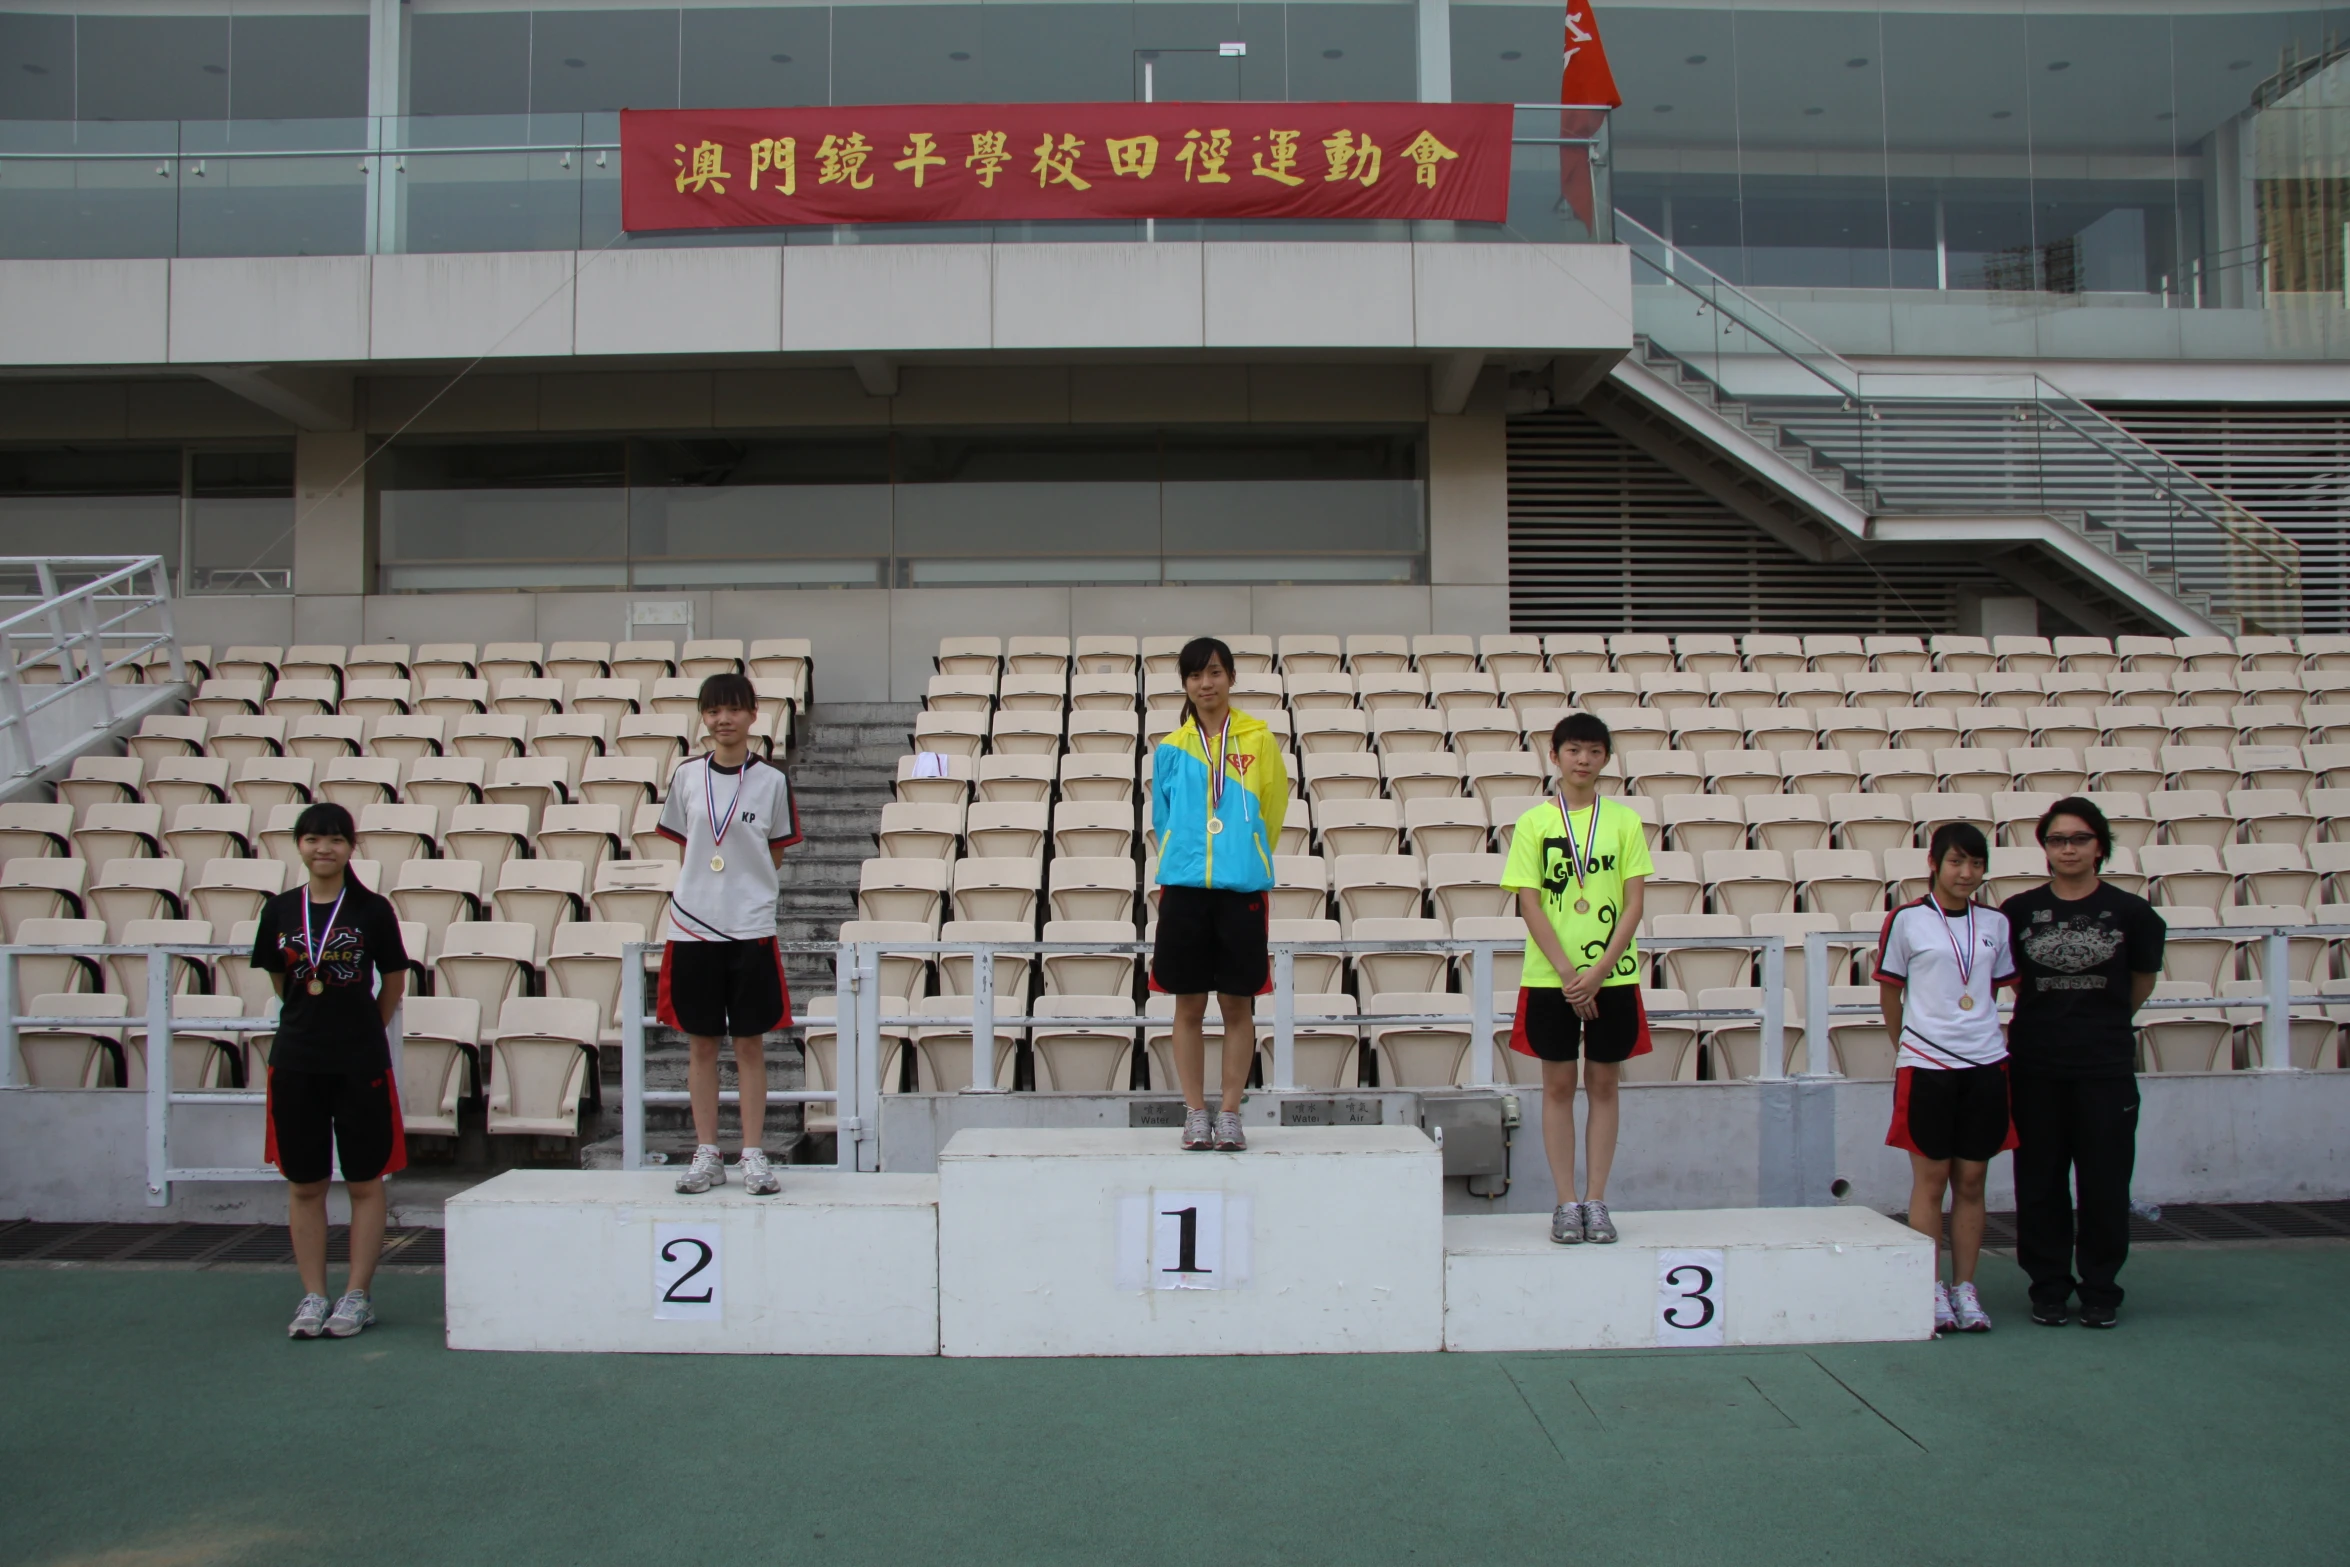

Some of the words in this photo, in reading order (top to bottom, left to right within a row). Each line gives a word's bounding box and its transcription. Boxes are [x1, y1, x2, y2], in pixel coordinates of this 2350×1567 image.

[673, 128, 1460, 197] 澳門鏡平學校田徑運動會
[741, 811, 756, 824] KP
[1140, 1115, 1170, 1125] Water
[1292, 1114, 1320, 1123] Water
[1349, 1114, 1364, 1122] Air
[1161, 1206, 1212, 1273] 1
[661, 1237, 713, 1303] 2
[1663, 1265, 1714, 1329] 3
